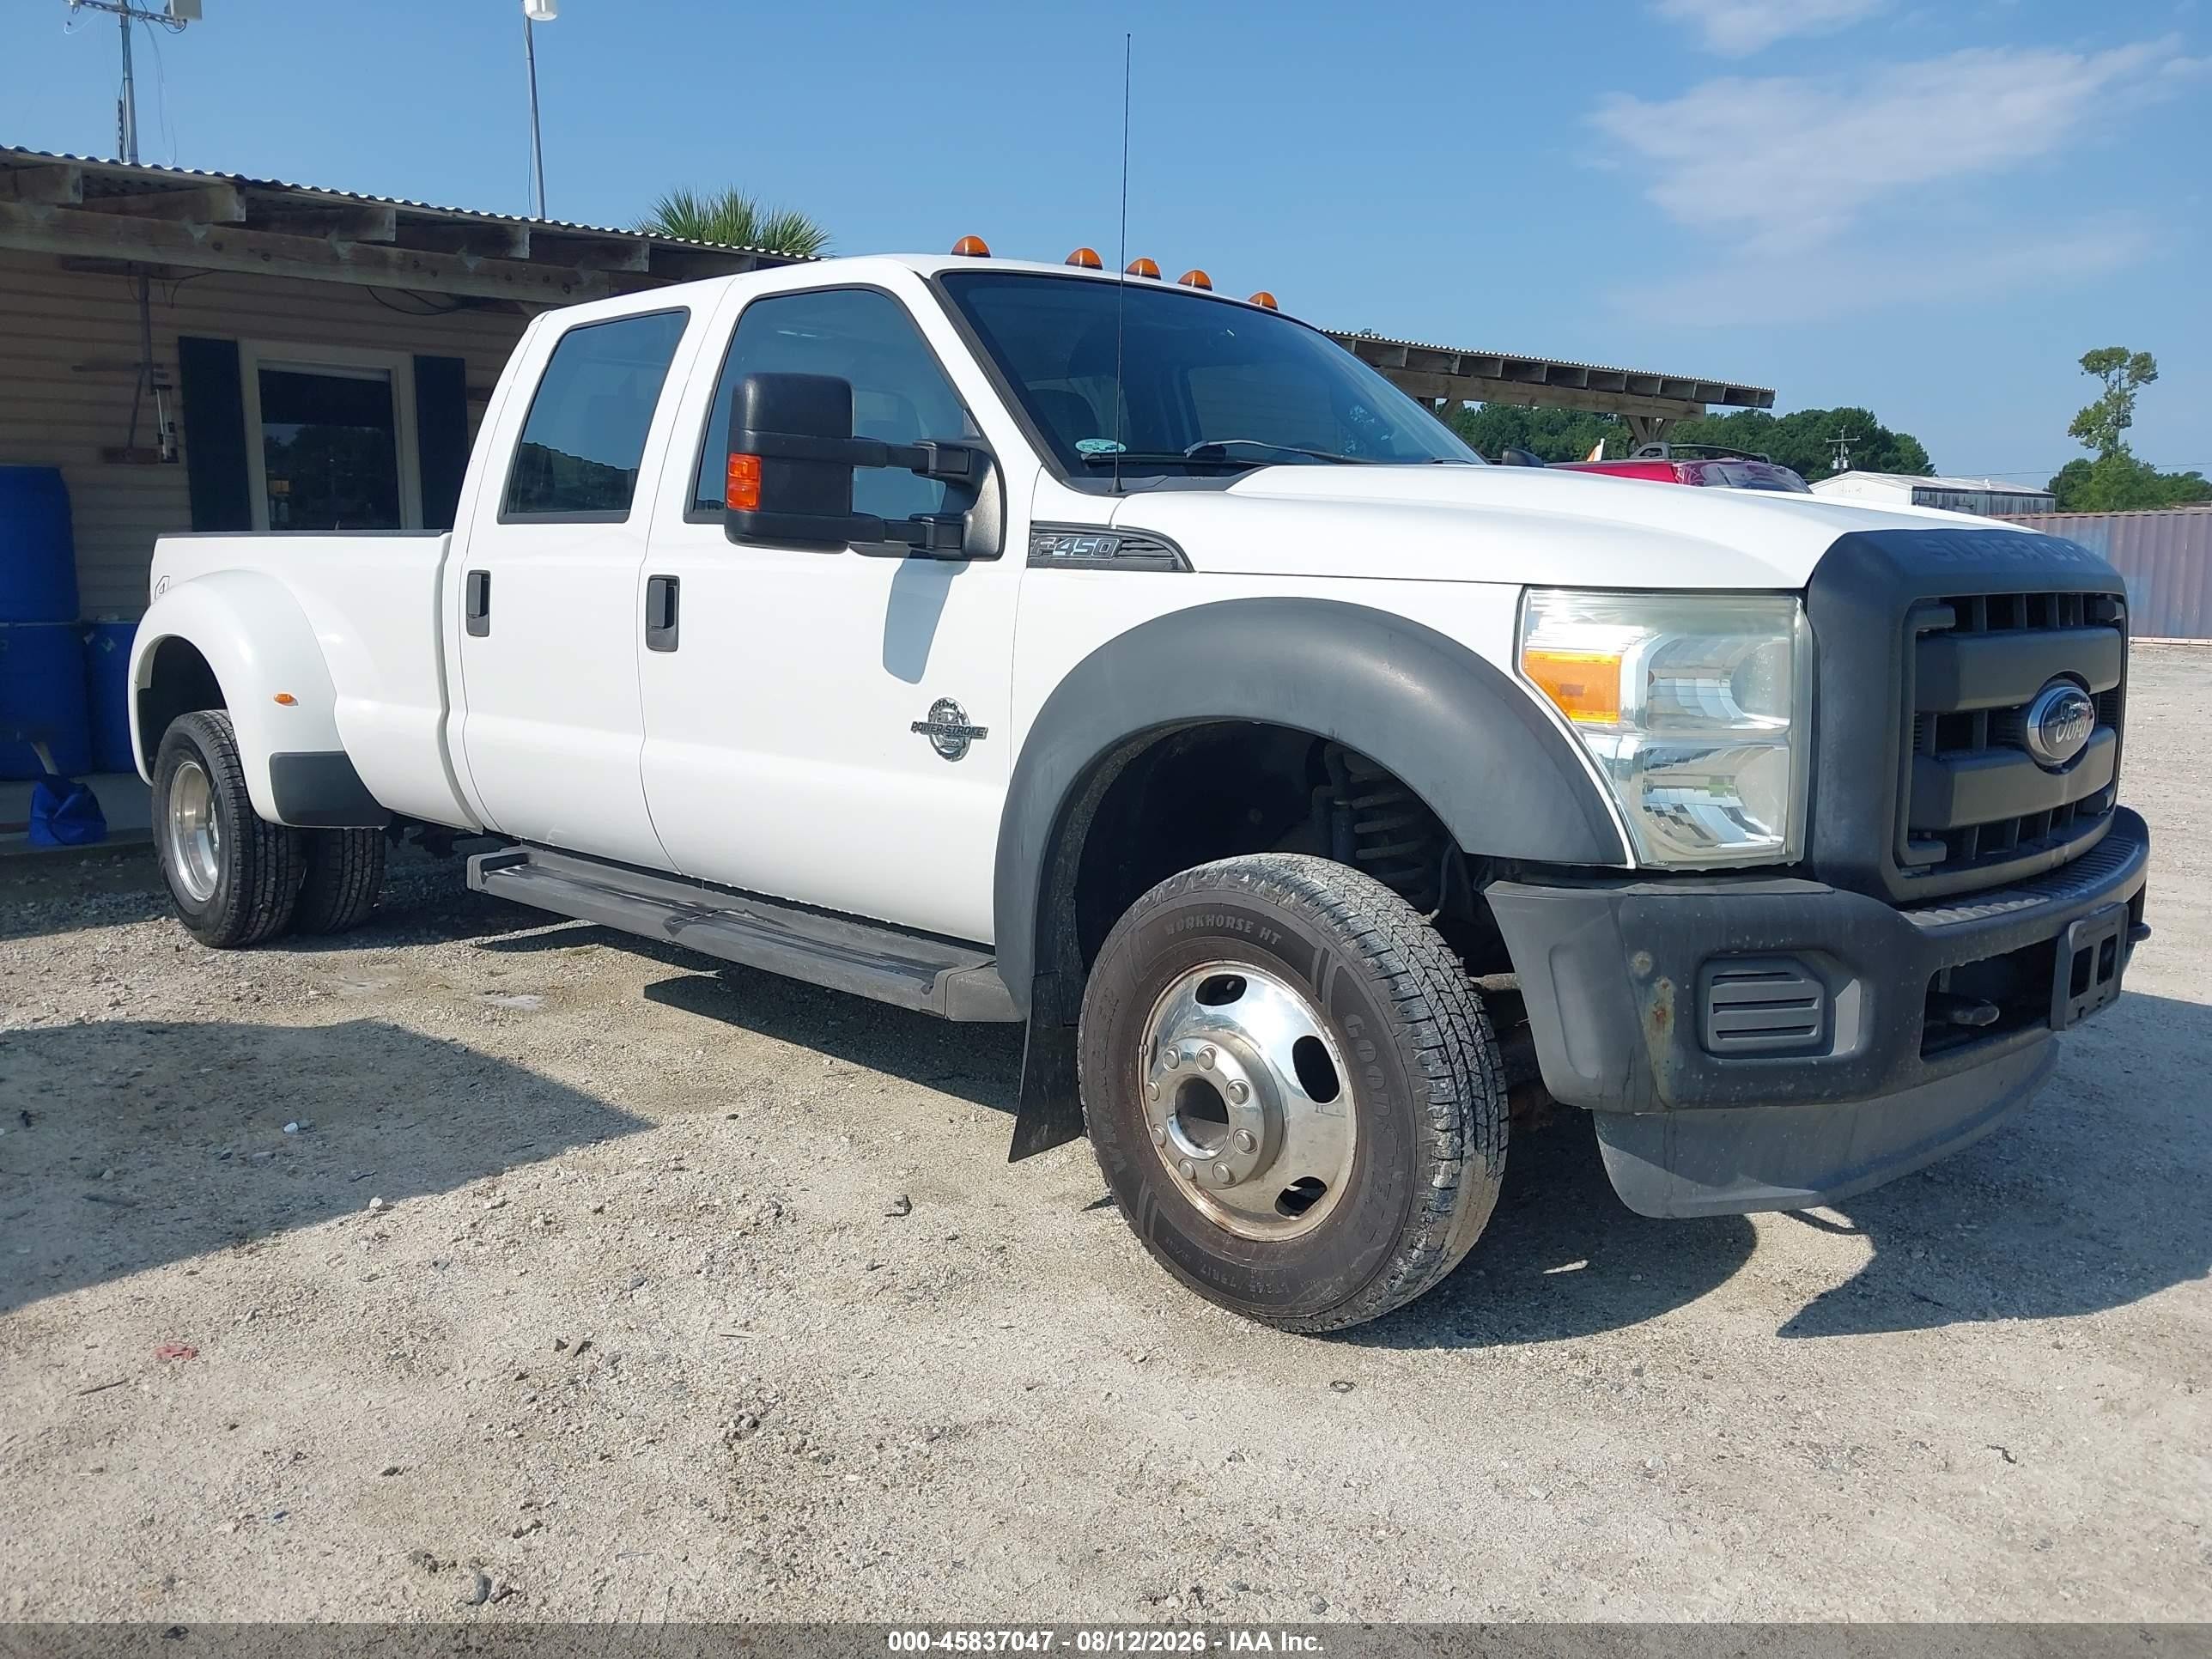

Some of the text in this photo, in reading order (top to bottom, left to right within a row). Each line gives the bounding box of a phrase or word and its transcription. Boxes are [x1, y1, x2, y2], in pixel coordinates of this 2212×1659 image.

[1920, 538, 2039, 562] SUPER
[911, 721, 988, 738] POWER STROKE
[2056, 699, 2092, 744] Ford
[1164, 914, 1282, 945] WORKHORSE HT
